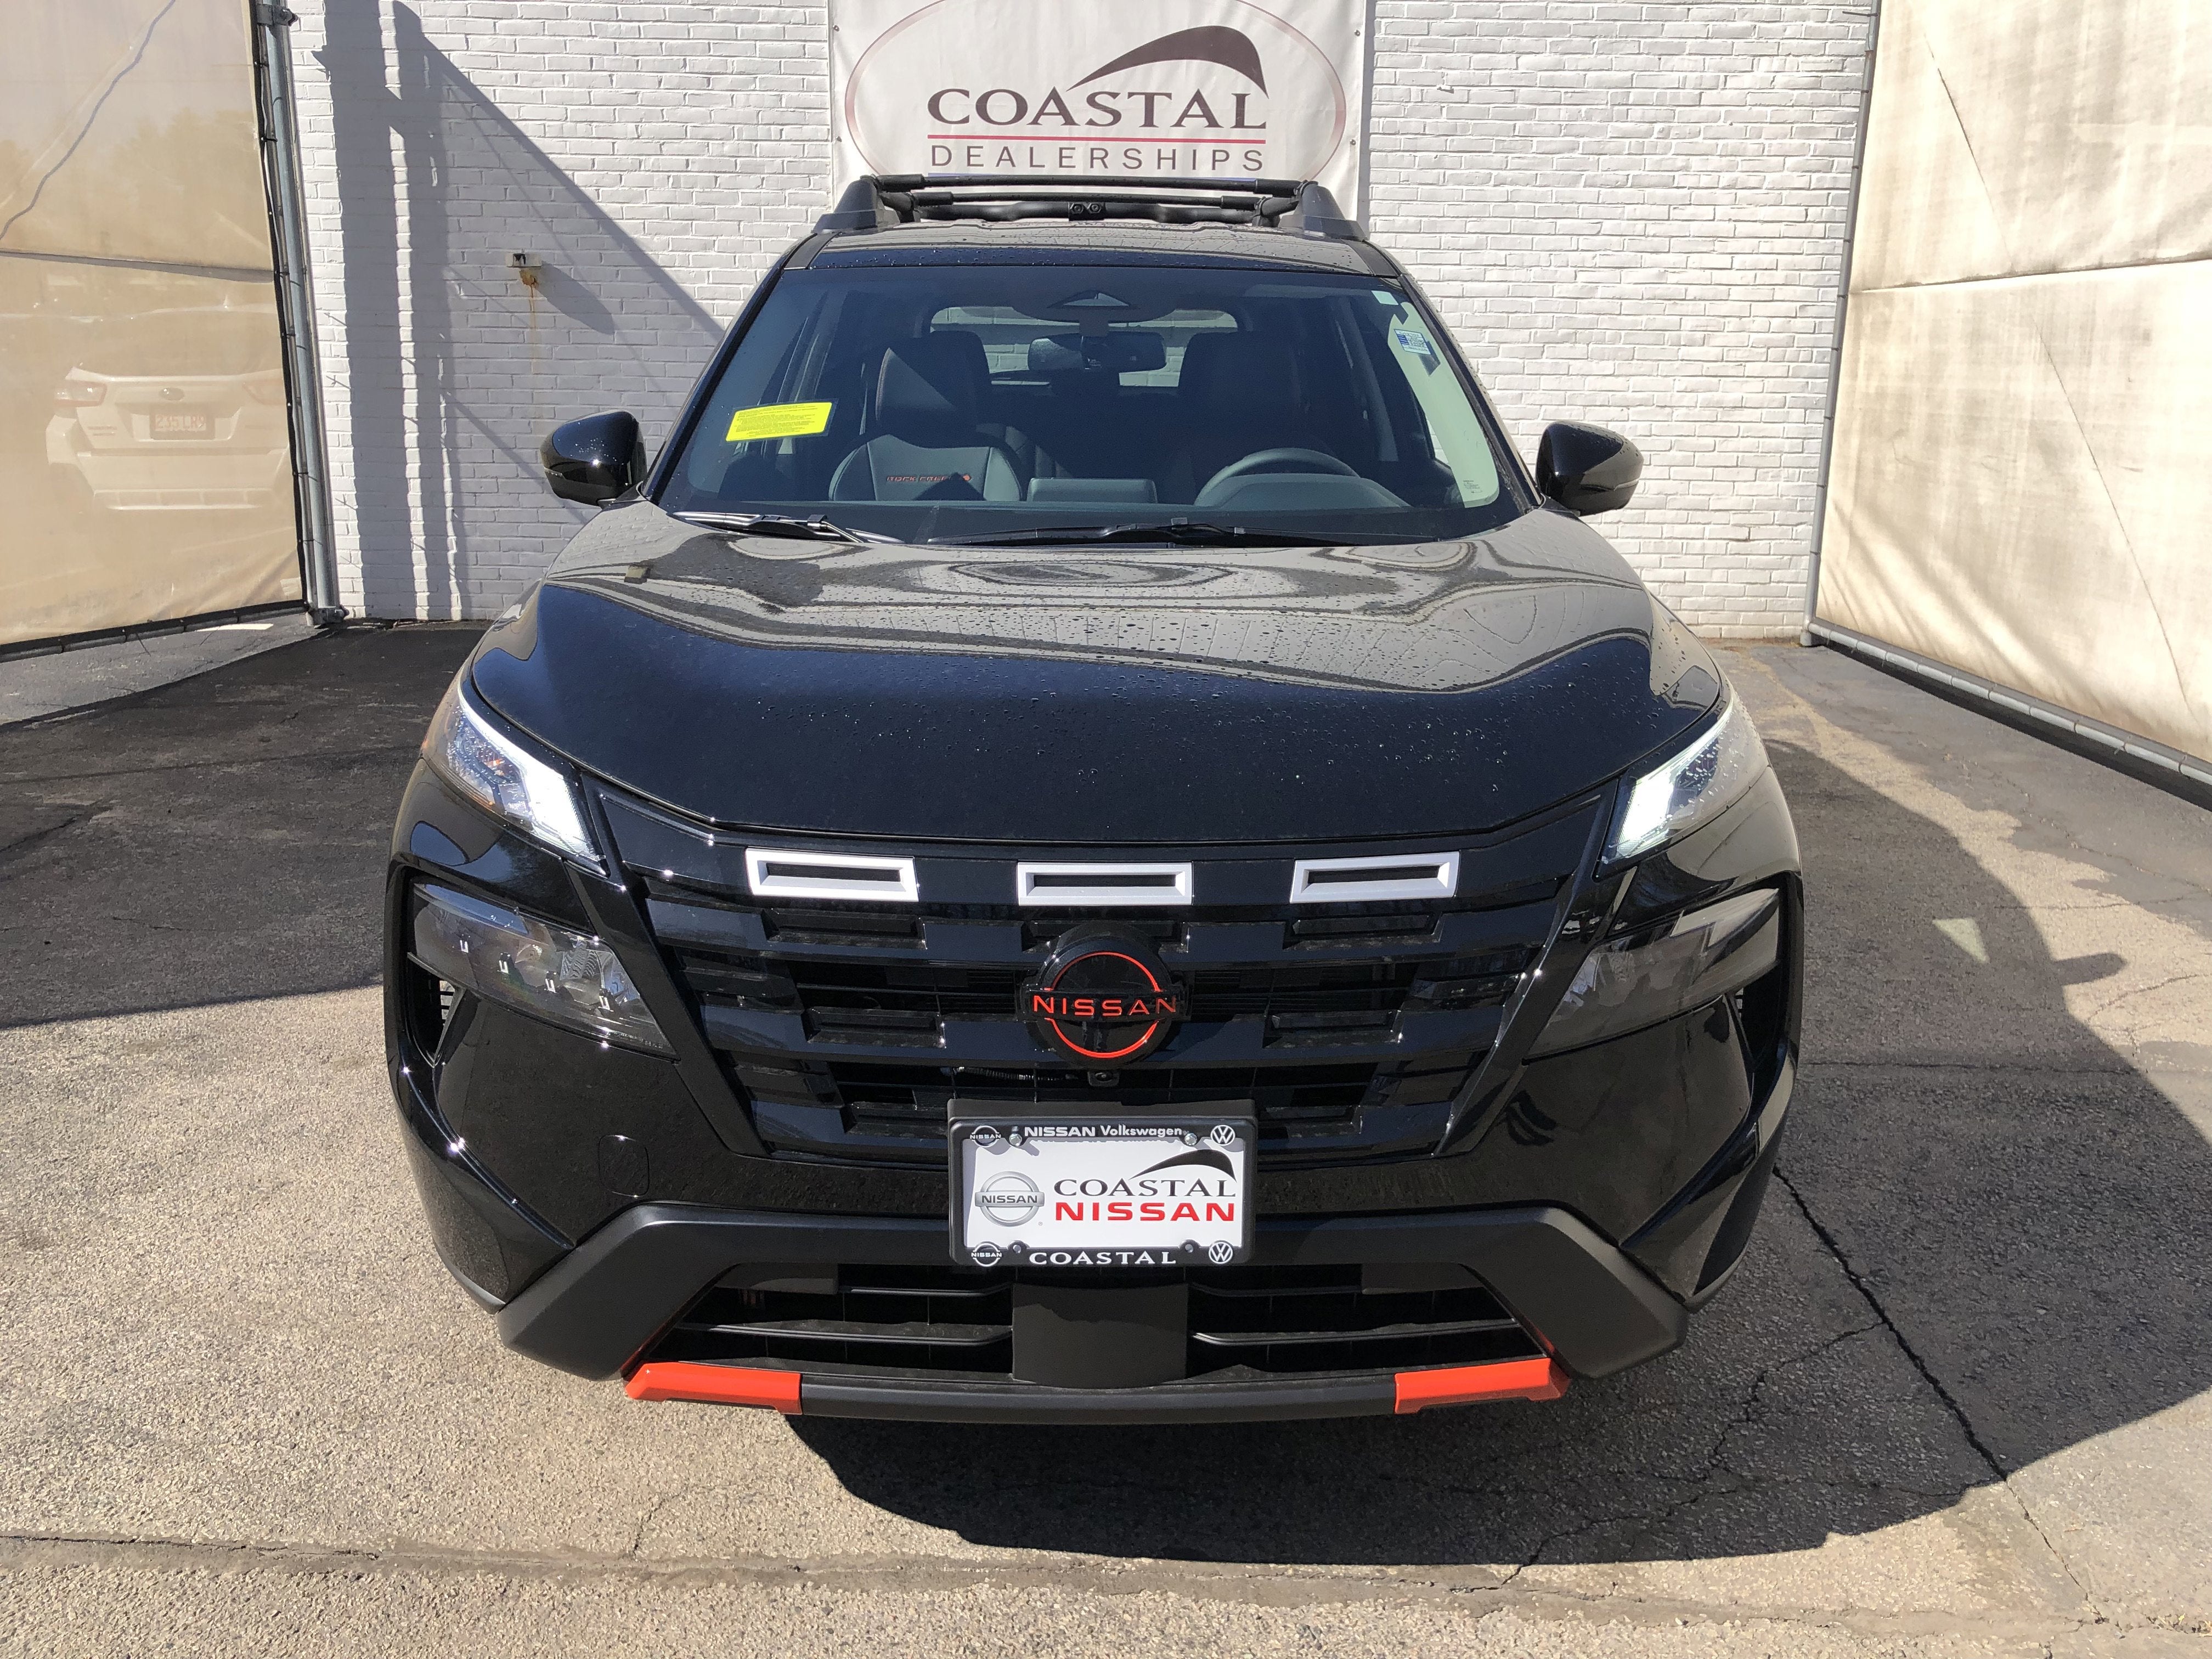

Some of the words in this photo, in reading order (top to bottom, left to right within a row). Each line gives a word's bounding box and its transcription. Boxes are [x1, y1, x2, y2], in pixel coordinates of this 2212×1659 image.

[927, 86, 1266, 129] COASTAL
[932, 145, 1263, 171] DEALERSHIPS
[1033, 995, 1176, 1016] NISSAN
[1024, 1126, 1096, 1137] NISSAN
[1100, 1124, 1182, 1138] Volkswagen
[1053, 1177, 1236, 1197] COASTAL
[981, 1194, 1038, 1204] NISSAN
[1055, 1201, 1234, 1221] NISSAN
[1029, 1251, 1176, 1265] COASTAL
